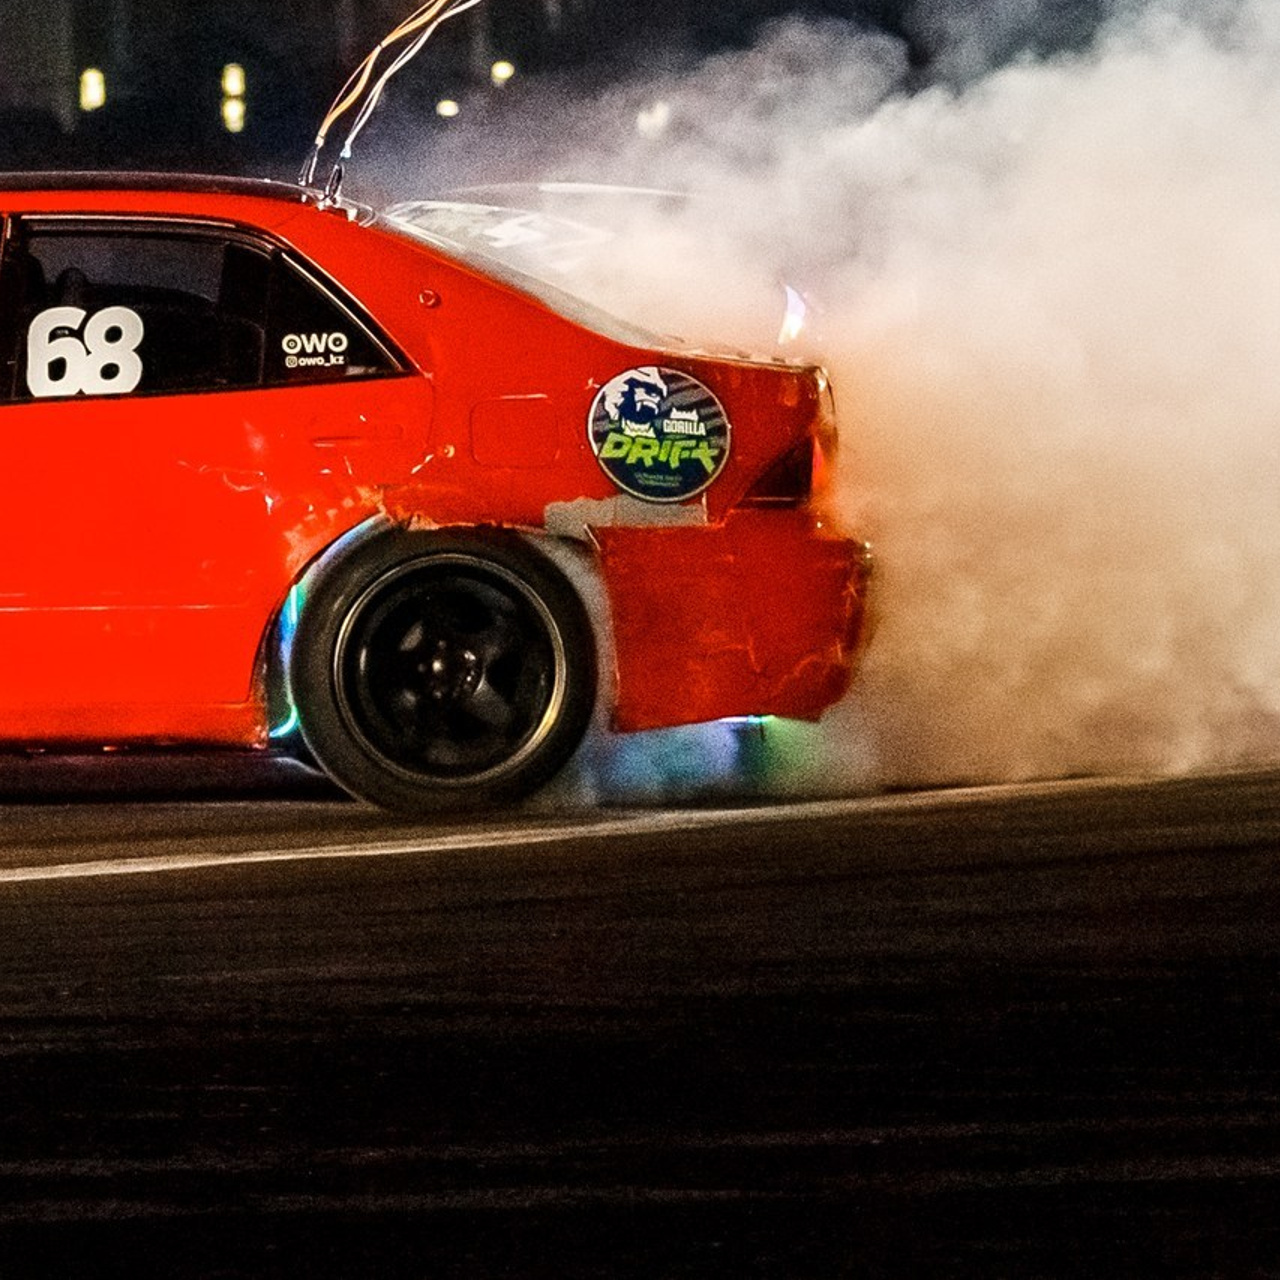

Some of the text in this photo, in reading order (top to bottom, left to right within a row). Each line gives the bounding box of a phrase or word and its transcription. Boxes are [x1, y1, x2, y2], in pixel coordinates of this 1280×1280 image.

[26, 306, 144, 398] 68
[282, 332, 348, 354] OWO
[663, 419, 706, 436] GORILLA
[600, 432, 719, 474] DRIFT
